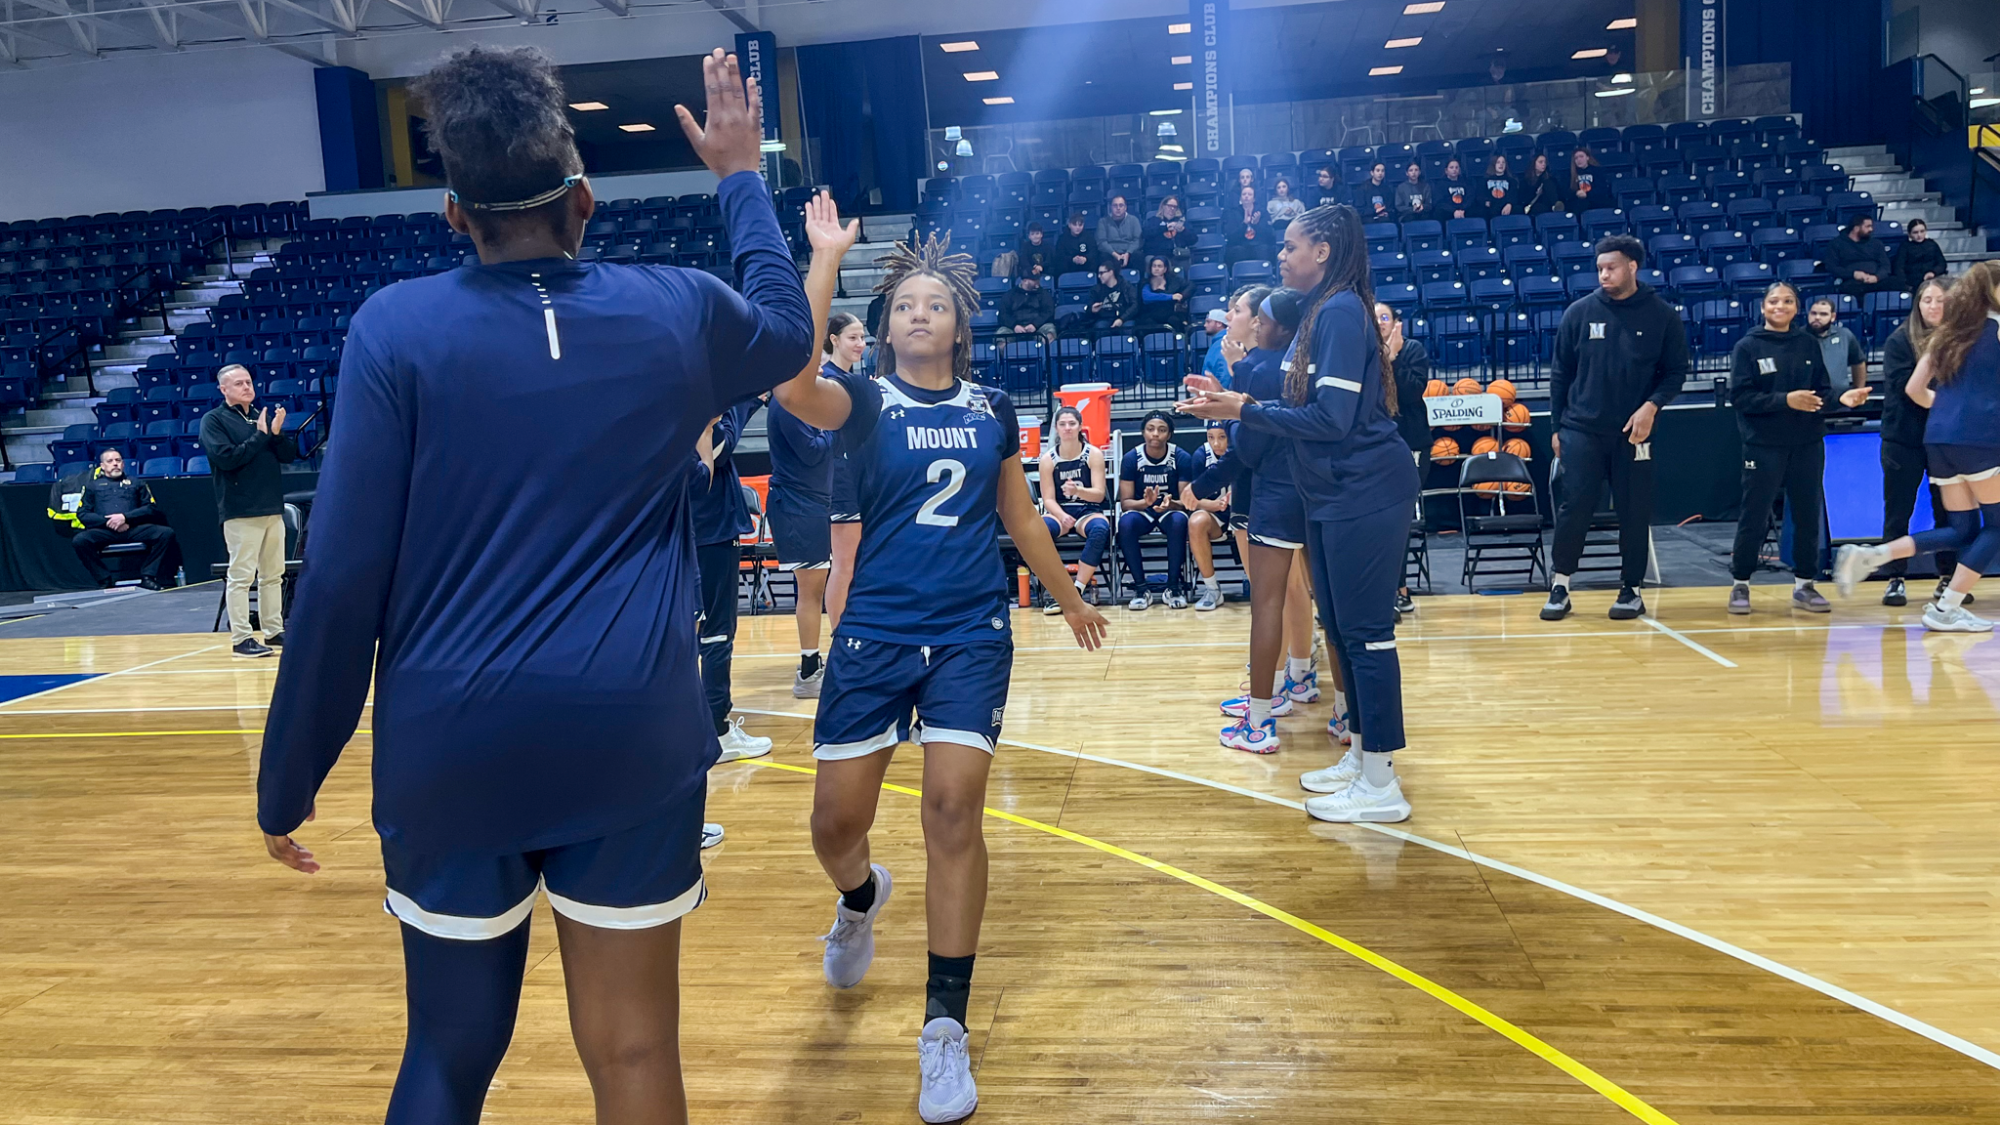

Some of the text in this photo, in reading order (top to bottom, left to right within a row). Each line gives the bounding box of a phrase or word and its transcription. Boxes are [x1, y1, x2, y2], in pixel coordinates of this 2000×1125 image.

[1702, 9, 1715, 114] CHAMPIONS
[1204, 3, 1219, 151] CHAMPIONS CLUB
[1589, 322, 1605, 339] M
[1757, 357, 1777, 375] M
[1432, 406, 1483, 420] SPALDING
[906, 426, 977, 450] MOUNT
[1059, 468, 1082, 481] MOUNT
[1143, 473, 1168, 484] MOUNT
[916, 458, 966, 526] 2
